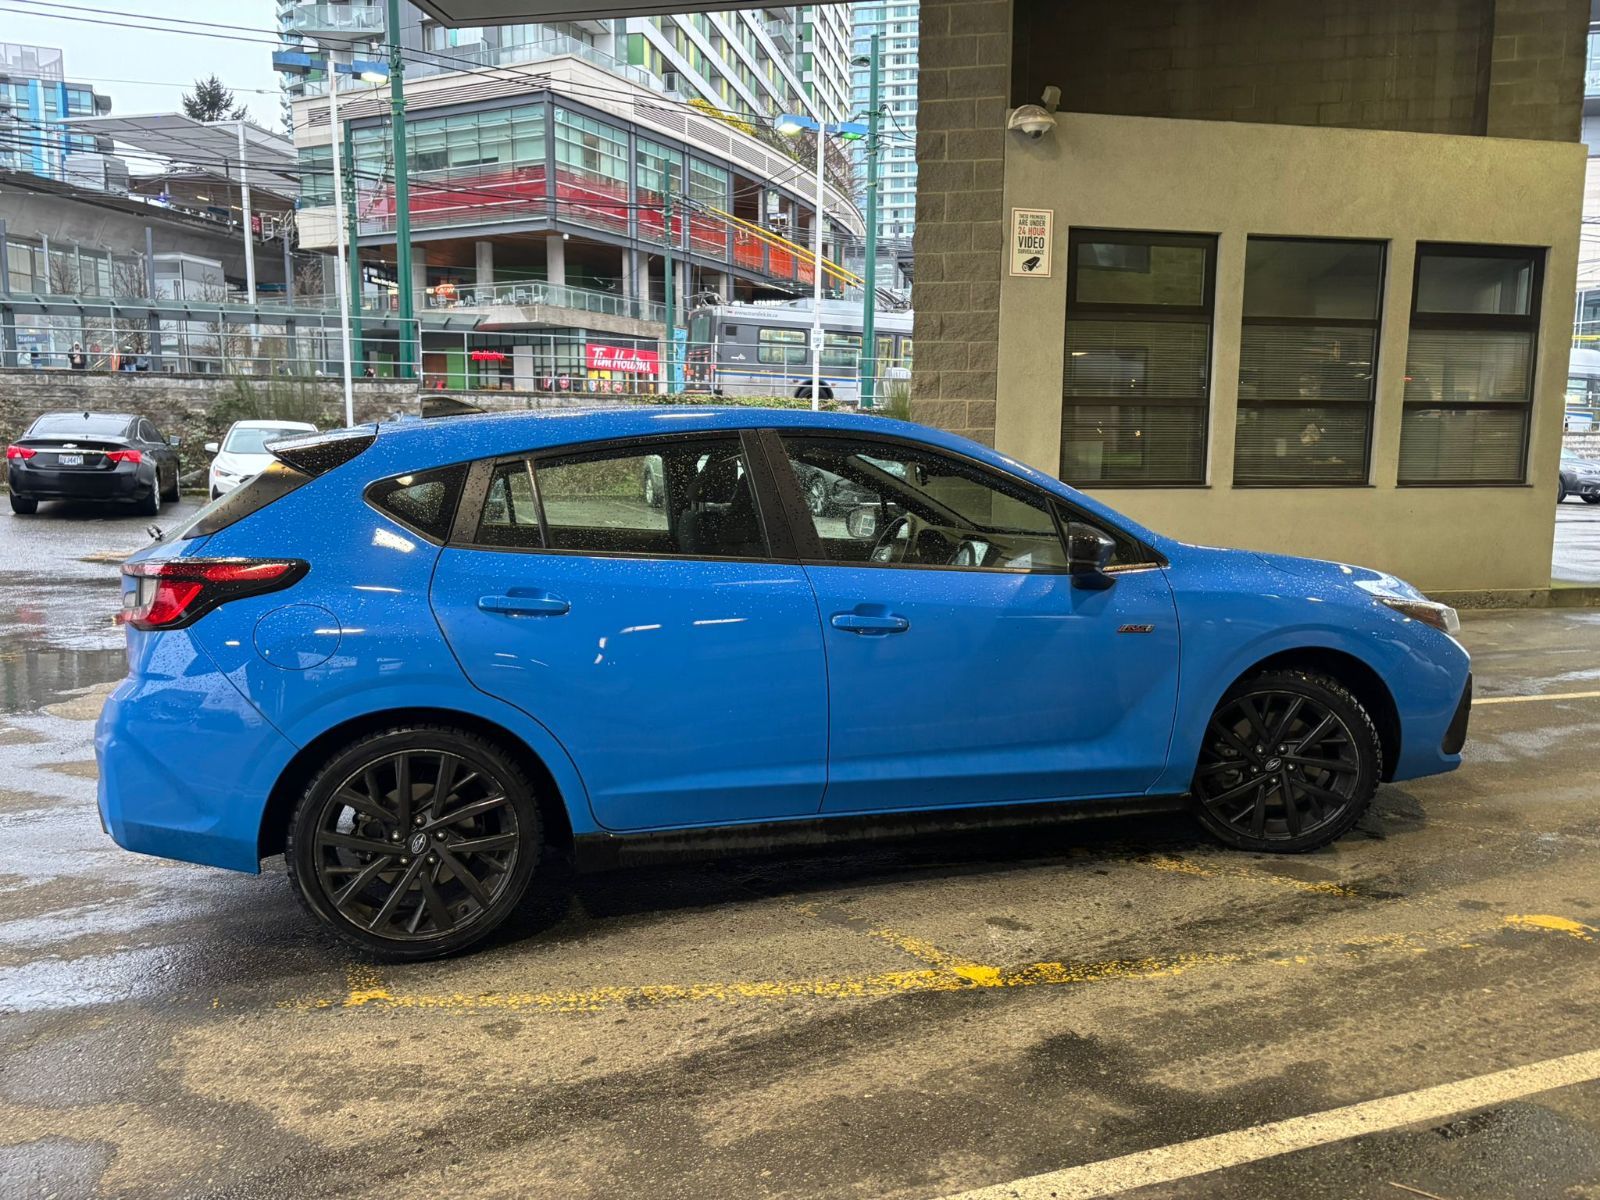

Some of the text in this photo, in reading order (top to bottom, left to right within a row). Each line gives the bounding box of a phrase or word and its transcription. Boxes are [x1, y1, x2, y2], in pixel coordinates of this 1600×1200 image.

[1018, 226, 1046, 236] 24 HOUR
[1018, 236, 1044, 248] VIDEO
[592, 347, 611, 368] Tim
